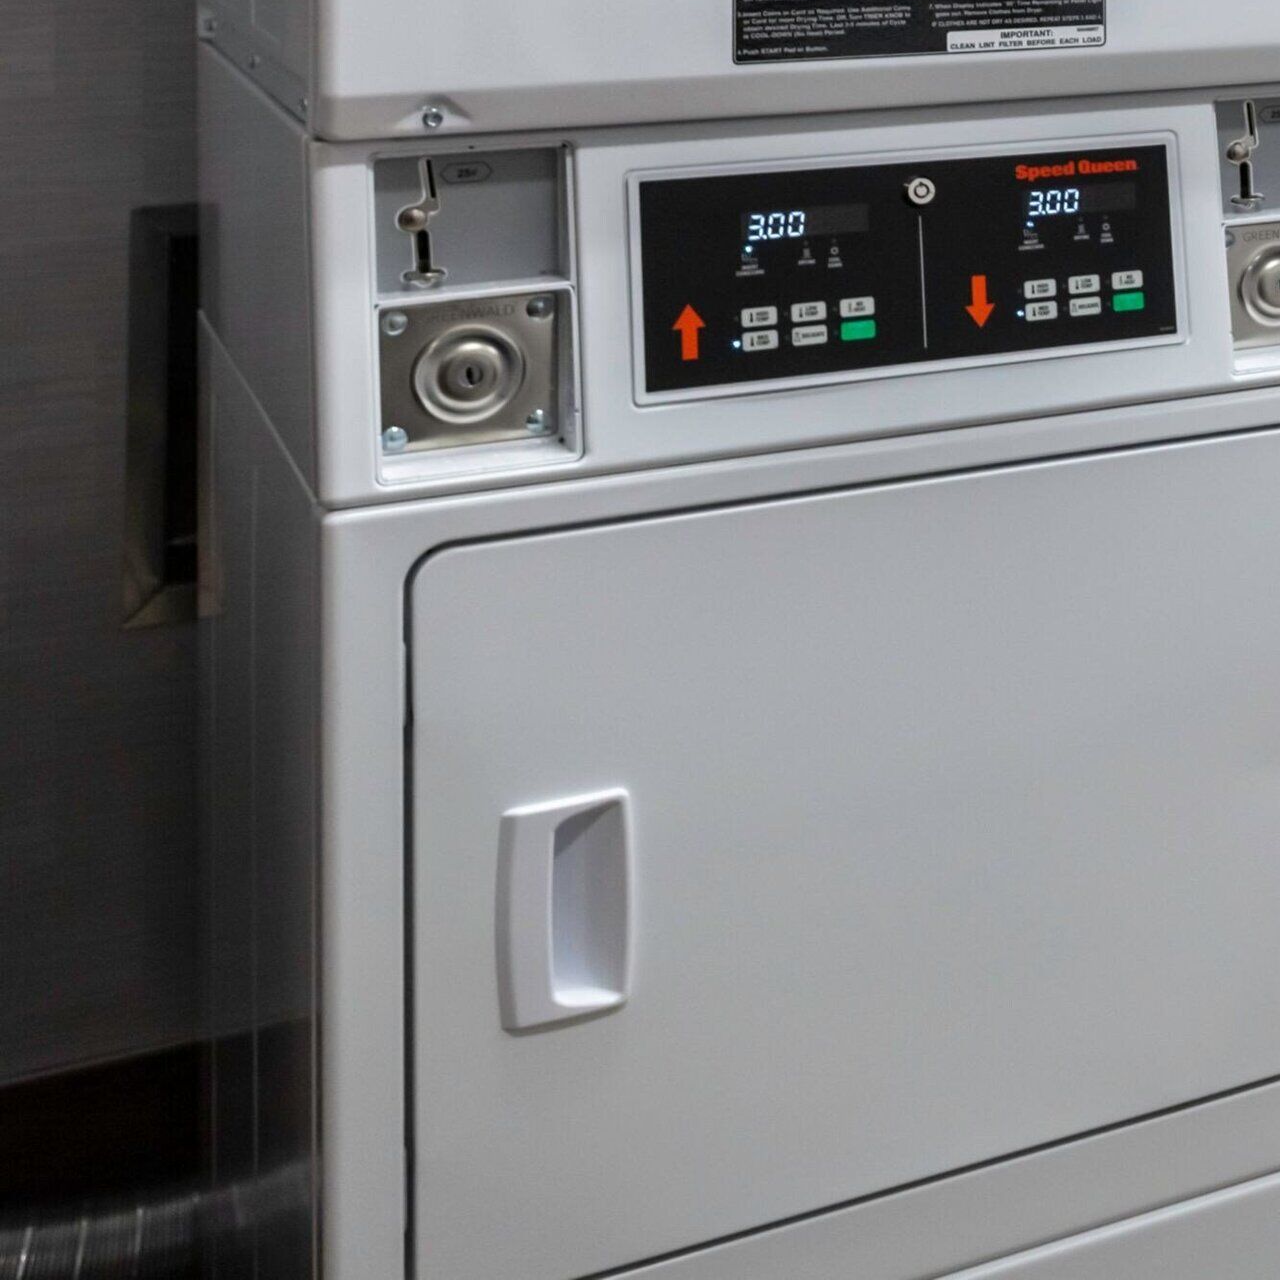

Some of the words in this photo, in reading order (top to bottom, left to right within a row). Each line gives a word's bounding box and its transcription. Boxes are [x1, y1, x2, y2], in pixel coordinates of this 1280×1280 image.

[950, 42, 975, 50] CLEAN
[979, 41, 995, 49] LINT
[999, 39, 1024, 48] FILTER
[1027, 37, 1056, 46] BEFORE
[1060, 36, 1079, 45] EACH
[1082, 35, 1102, 44] LOAD
[1015, 160, 1075, 182] Speed
[1077, 159, 1138, 175] Queen
[1029, 188, 1080, 216] 3.00
[748, 211, 806, 241] 3.00
